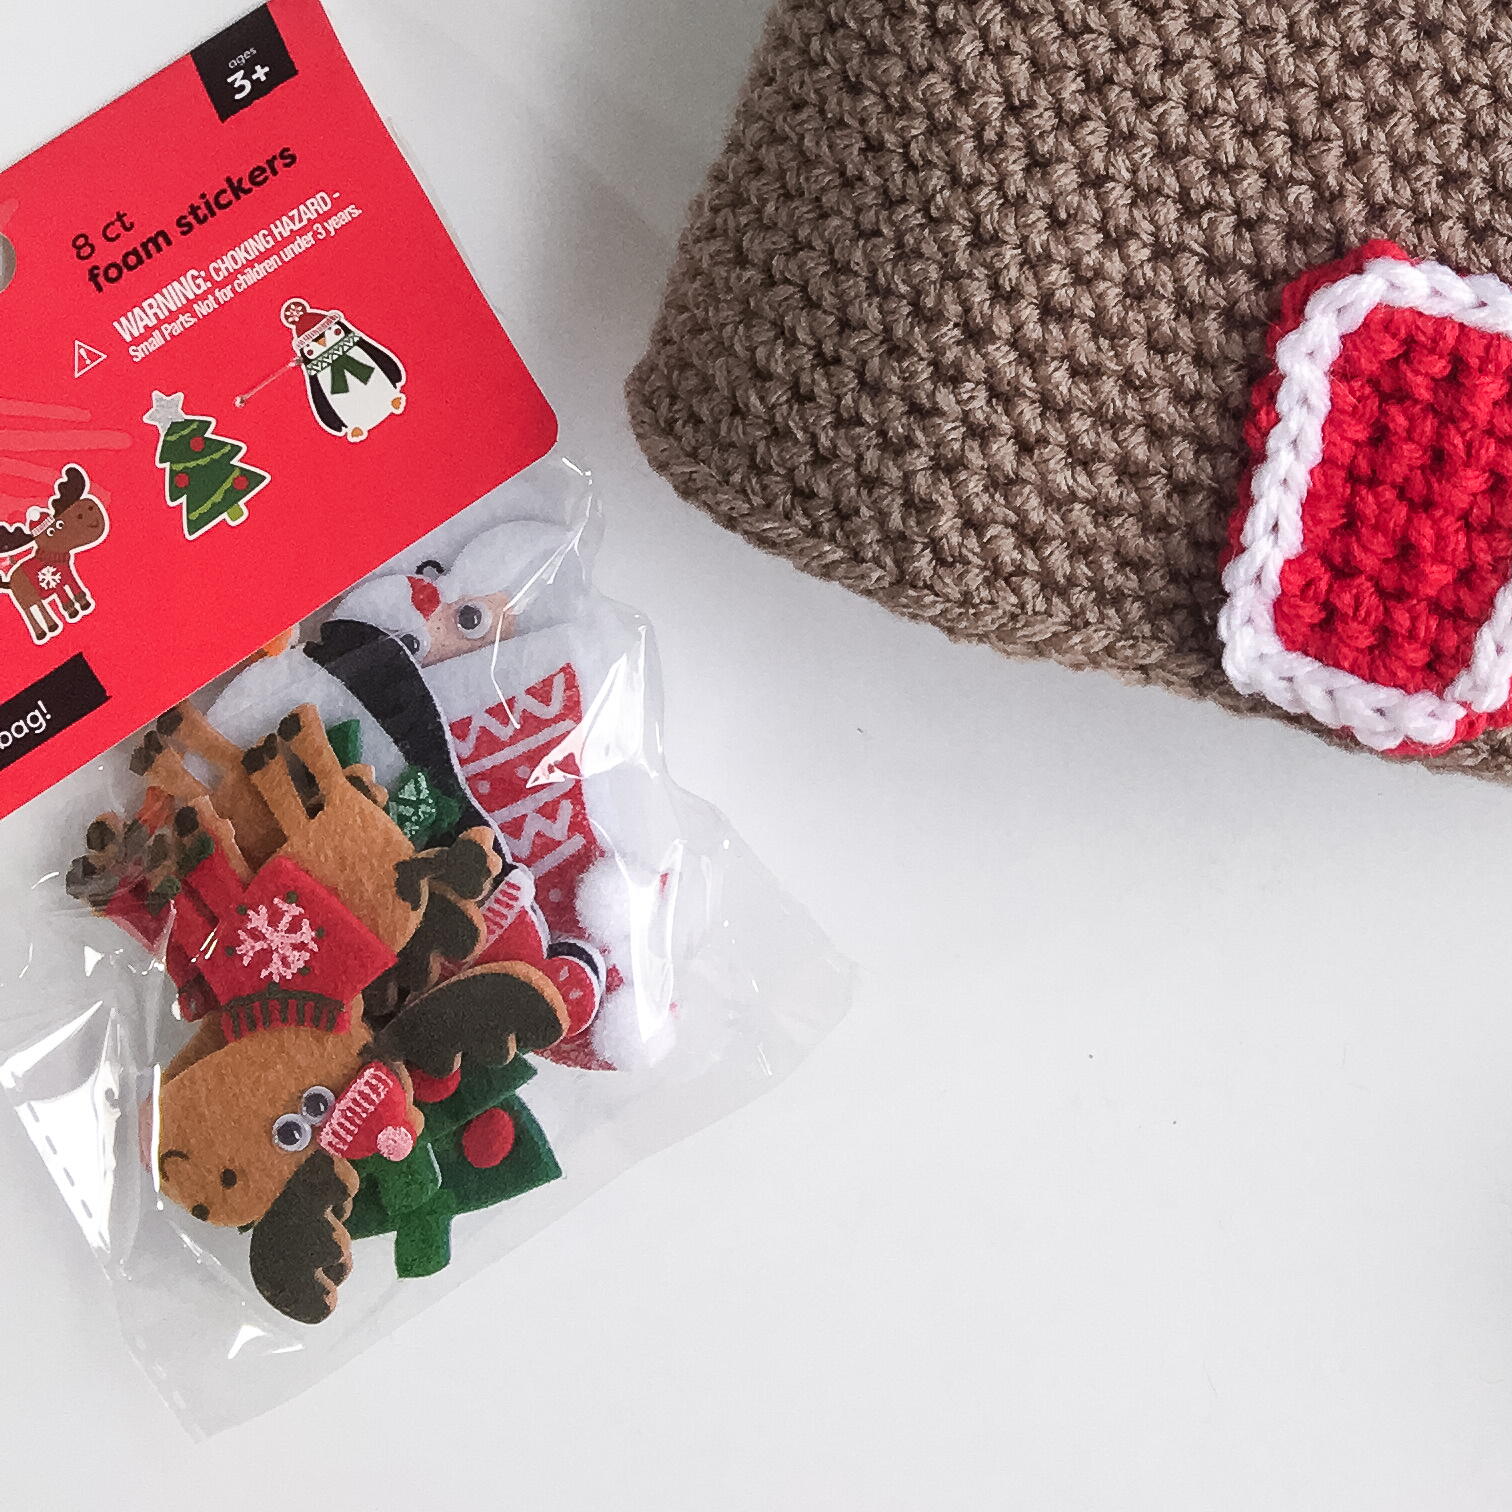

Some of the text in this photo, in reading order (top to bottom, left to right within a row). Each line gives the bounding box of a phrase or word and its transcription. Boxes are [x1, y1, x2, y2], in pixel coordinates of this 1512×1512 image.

[227, 64, 270, 100] 3+
[228, 46, 257, 70] ages
[72, 211, 135, 261] 8 ct
[87, 146, 298, 294] foam stickers
[112, 269, 212, 343] WARNING:
[208, 229, 275, 282] CHOKING
[269, 191, 332, 241] HAZARD
[128, 204, 363, 362] Small Parts. Not for children under 3 years.
